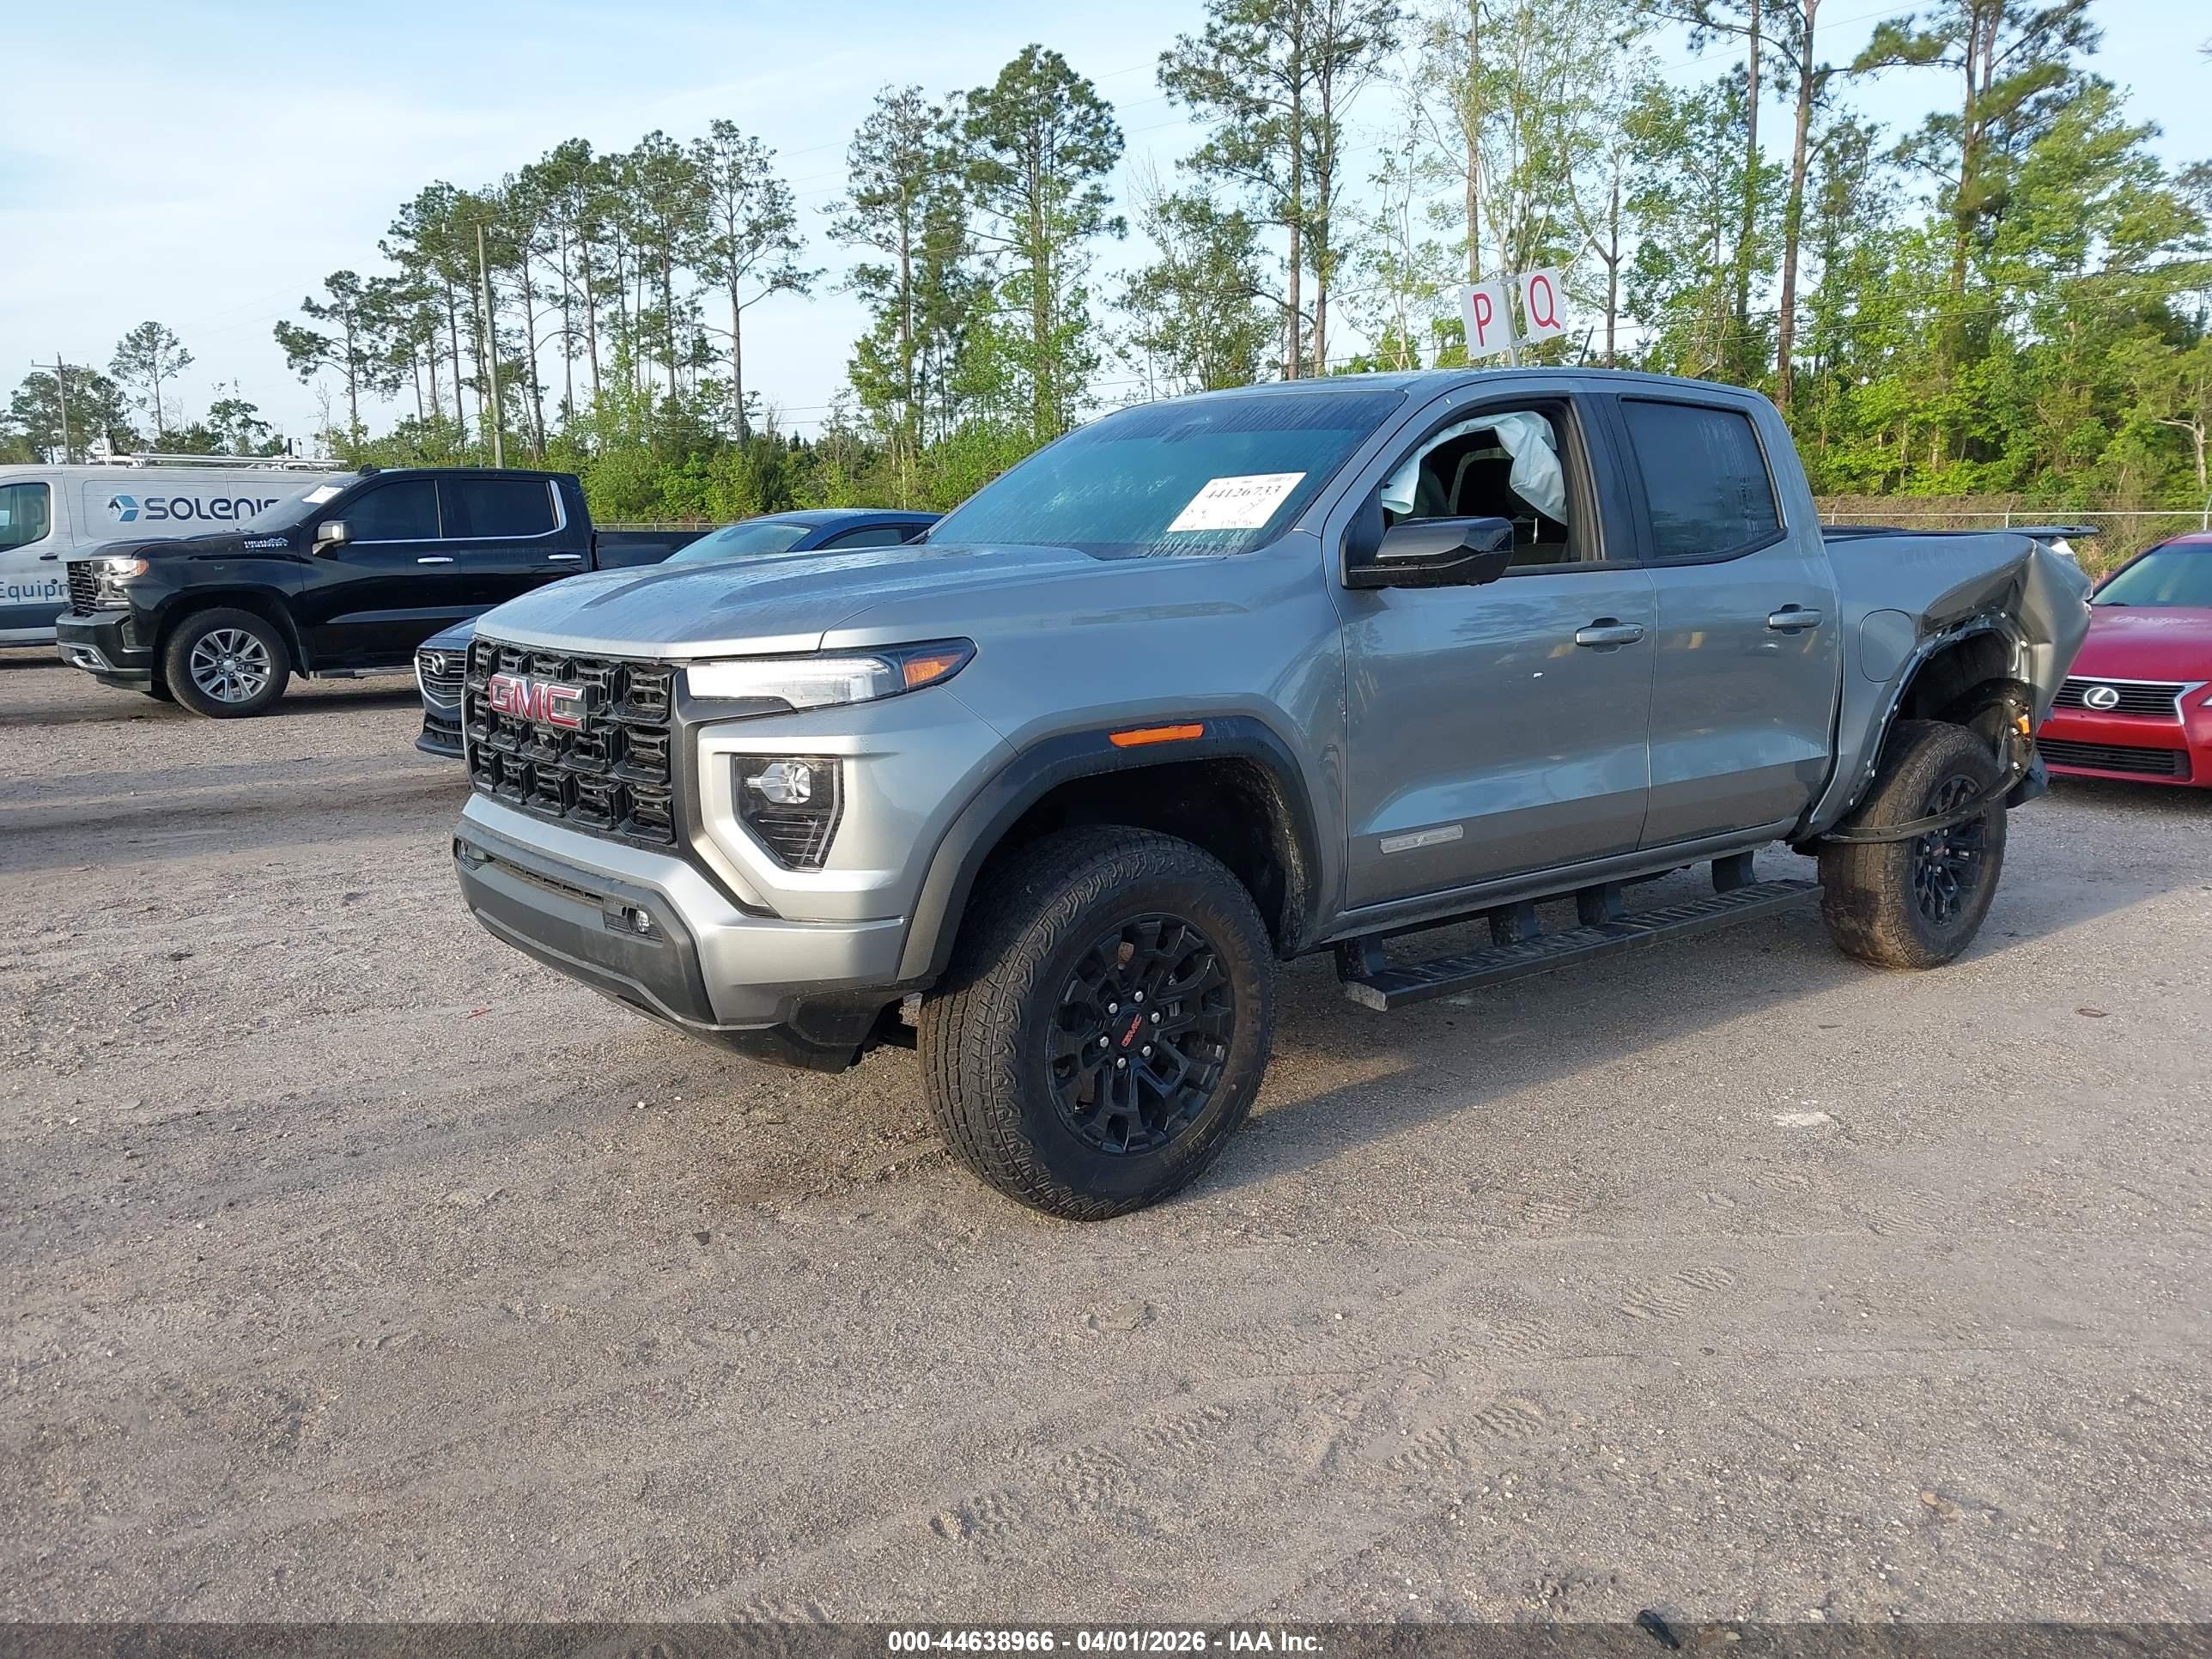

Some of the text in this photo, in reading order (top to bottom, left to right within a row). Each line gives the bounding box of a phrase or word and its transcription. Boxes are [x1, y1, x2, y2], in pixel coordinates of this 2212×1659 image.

[1472, 293, 1492, 348] P
[1529, 275, 1561, 331] Q
[1205, 484, 1282, 499] 44126733
[489, 672, 584, 731] GMC
[1121, 1012, 1142, 1048] GMC
